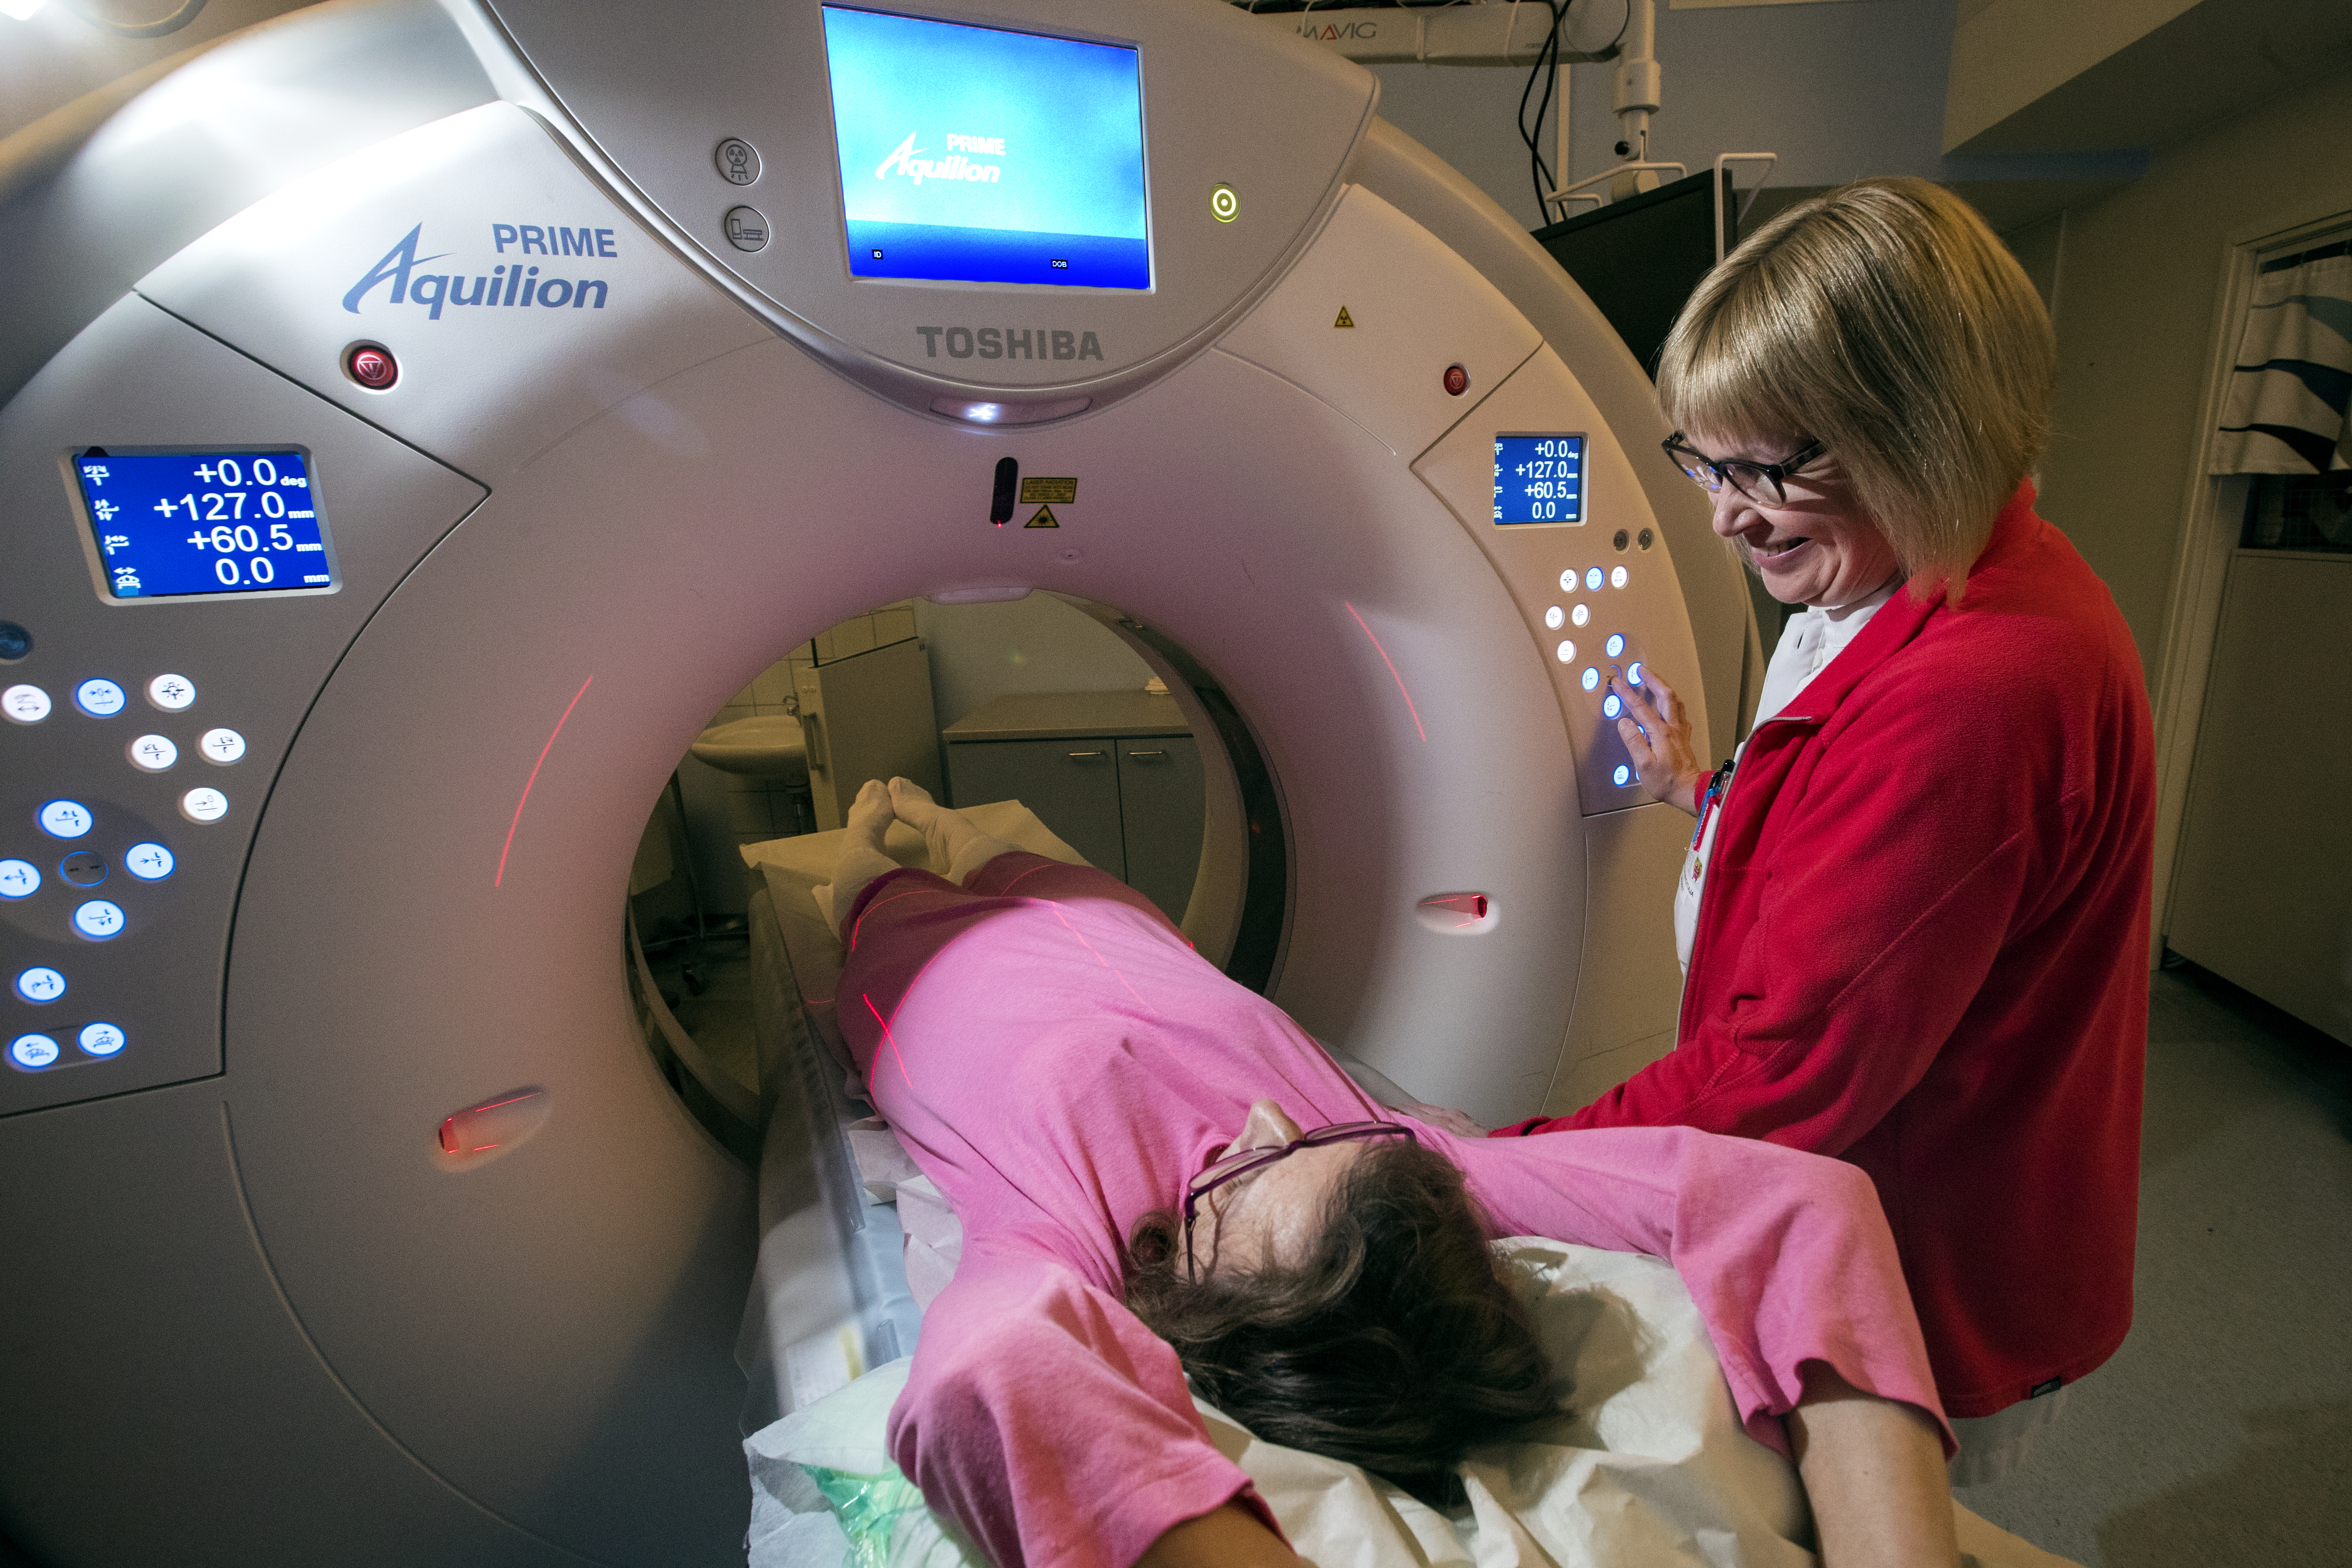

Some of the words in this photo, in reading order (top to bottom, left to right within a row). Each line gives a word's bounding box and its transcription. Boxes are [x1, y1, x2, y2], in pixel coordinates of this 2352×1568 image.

[875, 131, 1000, 185] Aquilion
[947, 133, 1006, 155] PRIME
[492, 223, 618, 258] PRIME
[342, 221, 608, 320] Aquilion
[916, 326, 1104, 361] TOSHIBA
[1535, 440, 1568, 458] +0.0
[193, 458, 277, 486] +0.0
[280, 476, 307, 488] deg
[1515, 461, 1567, 478] +127.0
[1524, 481, 1566, 499] +60.5
[154, 490, 285, 521] +127.0
[288, 510, 314, 519] mm
[1532, 501, 1556, 519] 0.0
[187, 524, 293, 553] +60.5
[296, 542, 322, 552] mm
[215, 557, 274, 585] 0.0
[304, 574, 329, 583] mm
